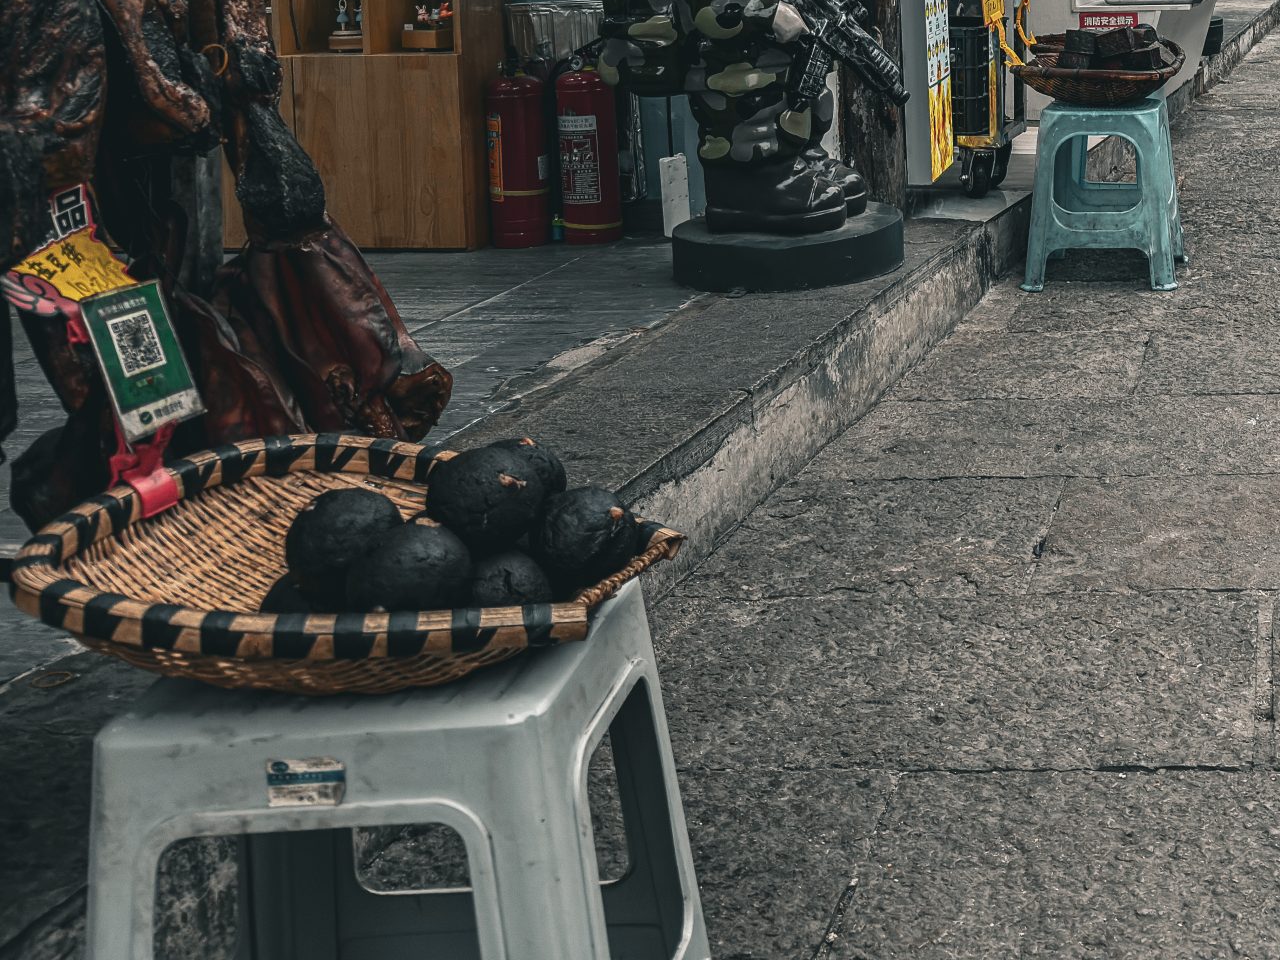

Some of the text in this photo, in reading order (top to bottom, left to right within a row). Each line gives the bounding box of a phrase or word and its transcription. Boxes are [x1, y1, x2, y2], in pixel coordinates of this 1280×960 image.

[1084, 16, 1134, 26] 消防安全提示
